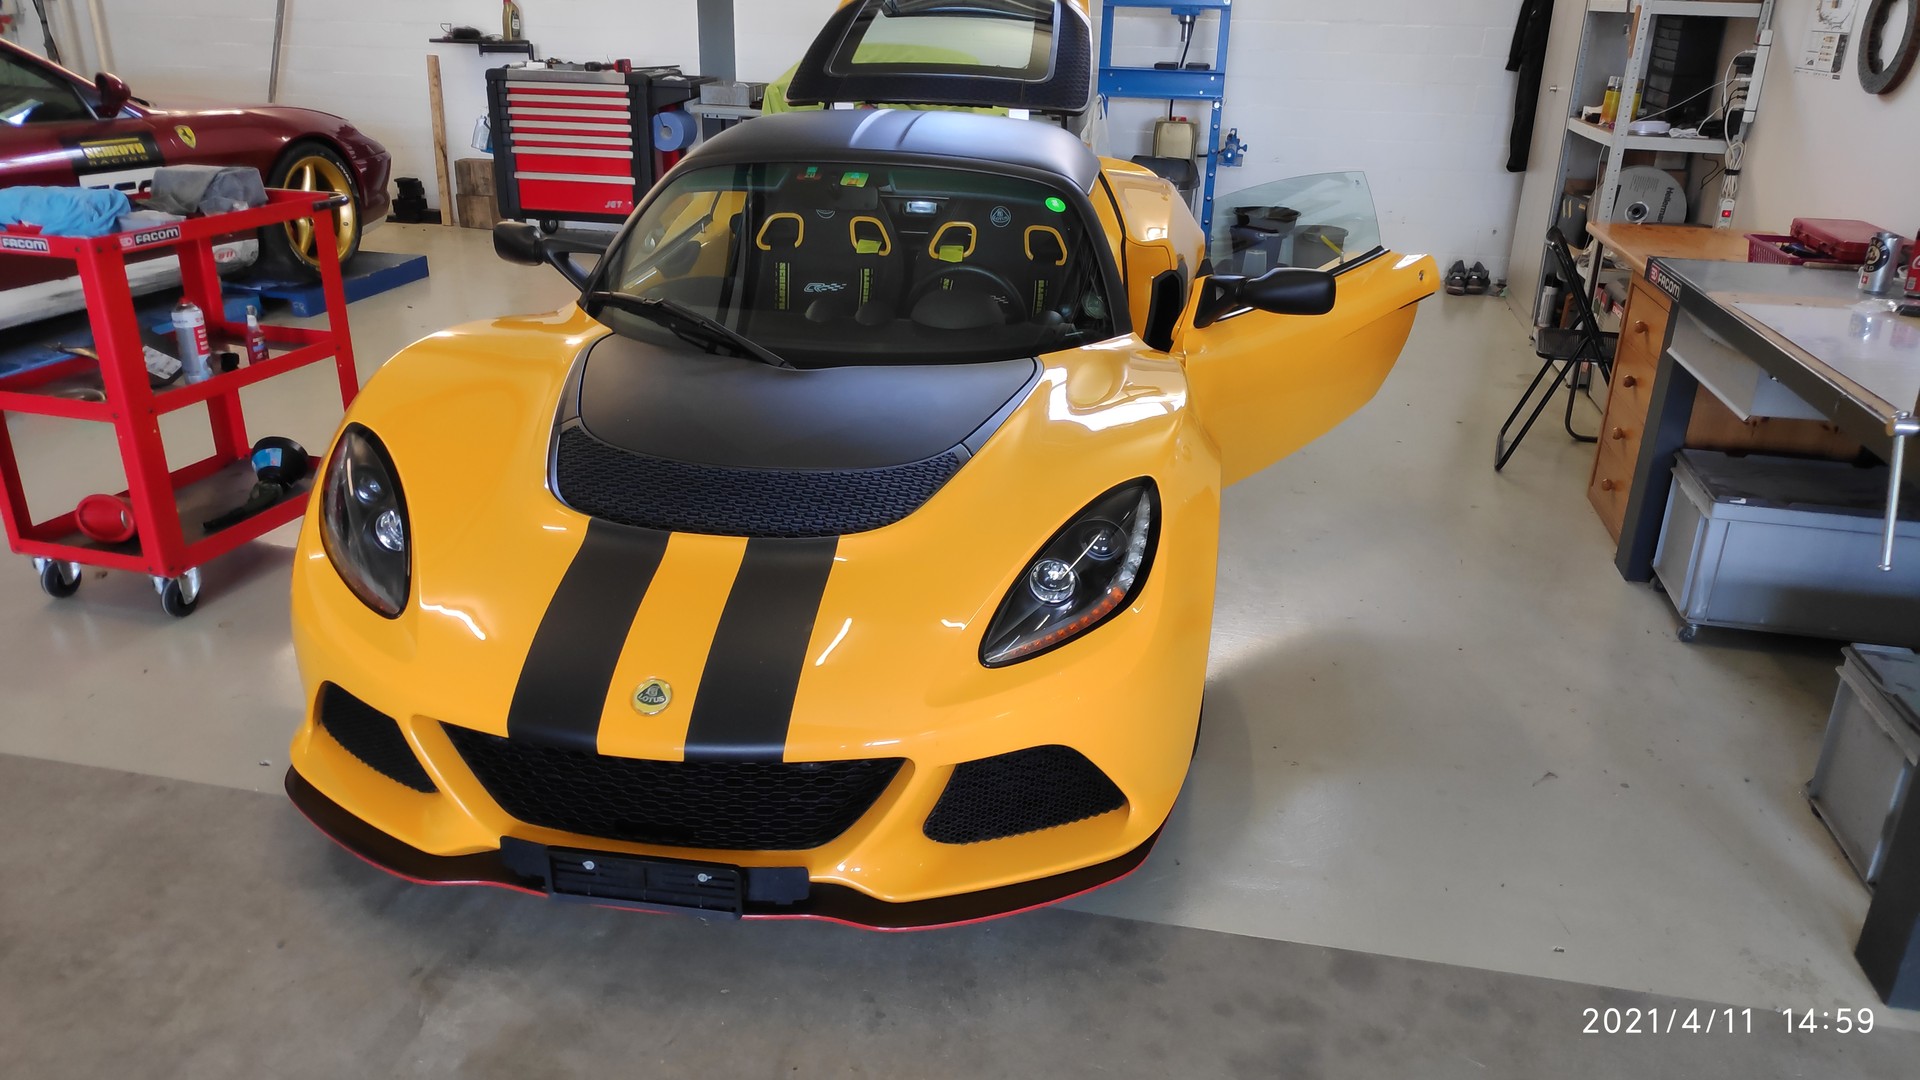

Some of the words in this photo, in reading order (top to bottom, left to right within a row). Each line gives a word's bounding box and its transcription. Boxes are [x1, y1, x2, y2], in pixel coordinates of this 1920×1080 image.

[88, 154, 149, 167] RACING
[135, 227, 179, 246] FACOM
[2, 237, 48, 251] FACOM
[1657, 272, 1681, 299] FACOM
[638, 693, 665, 703] LOTUS
